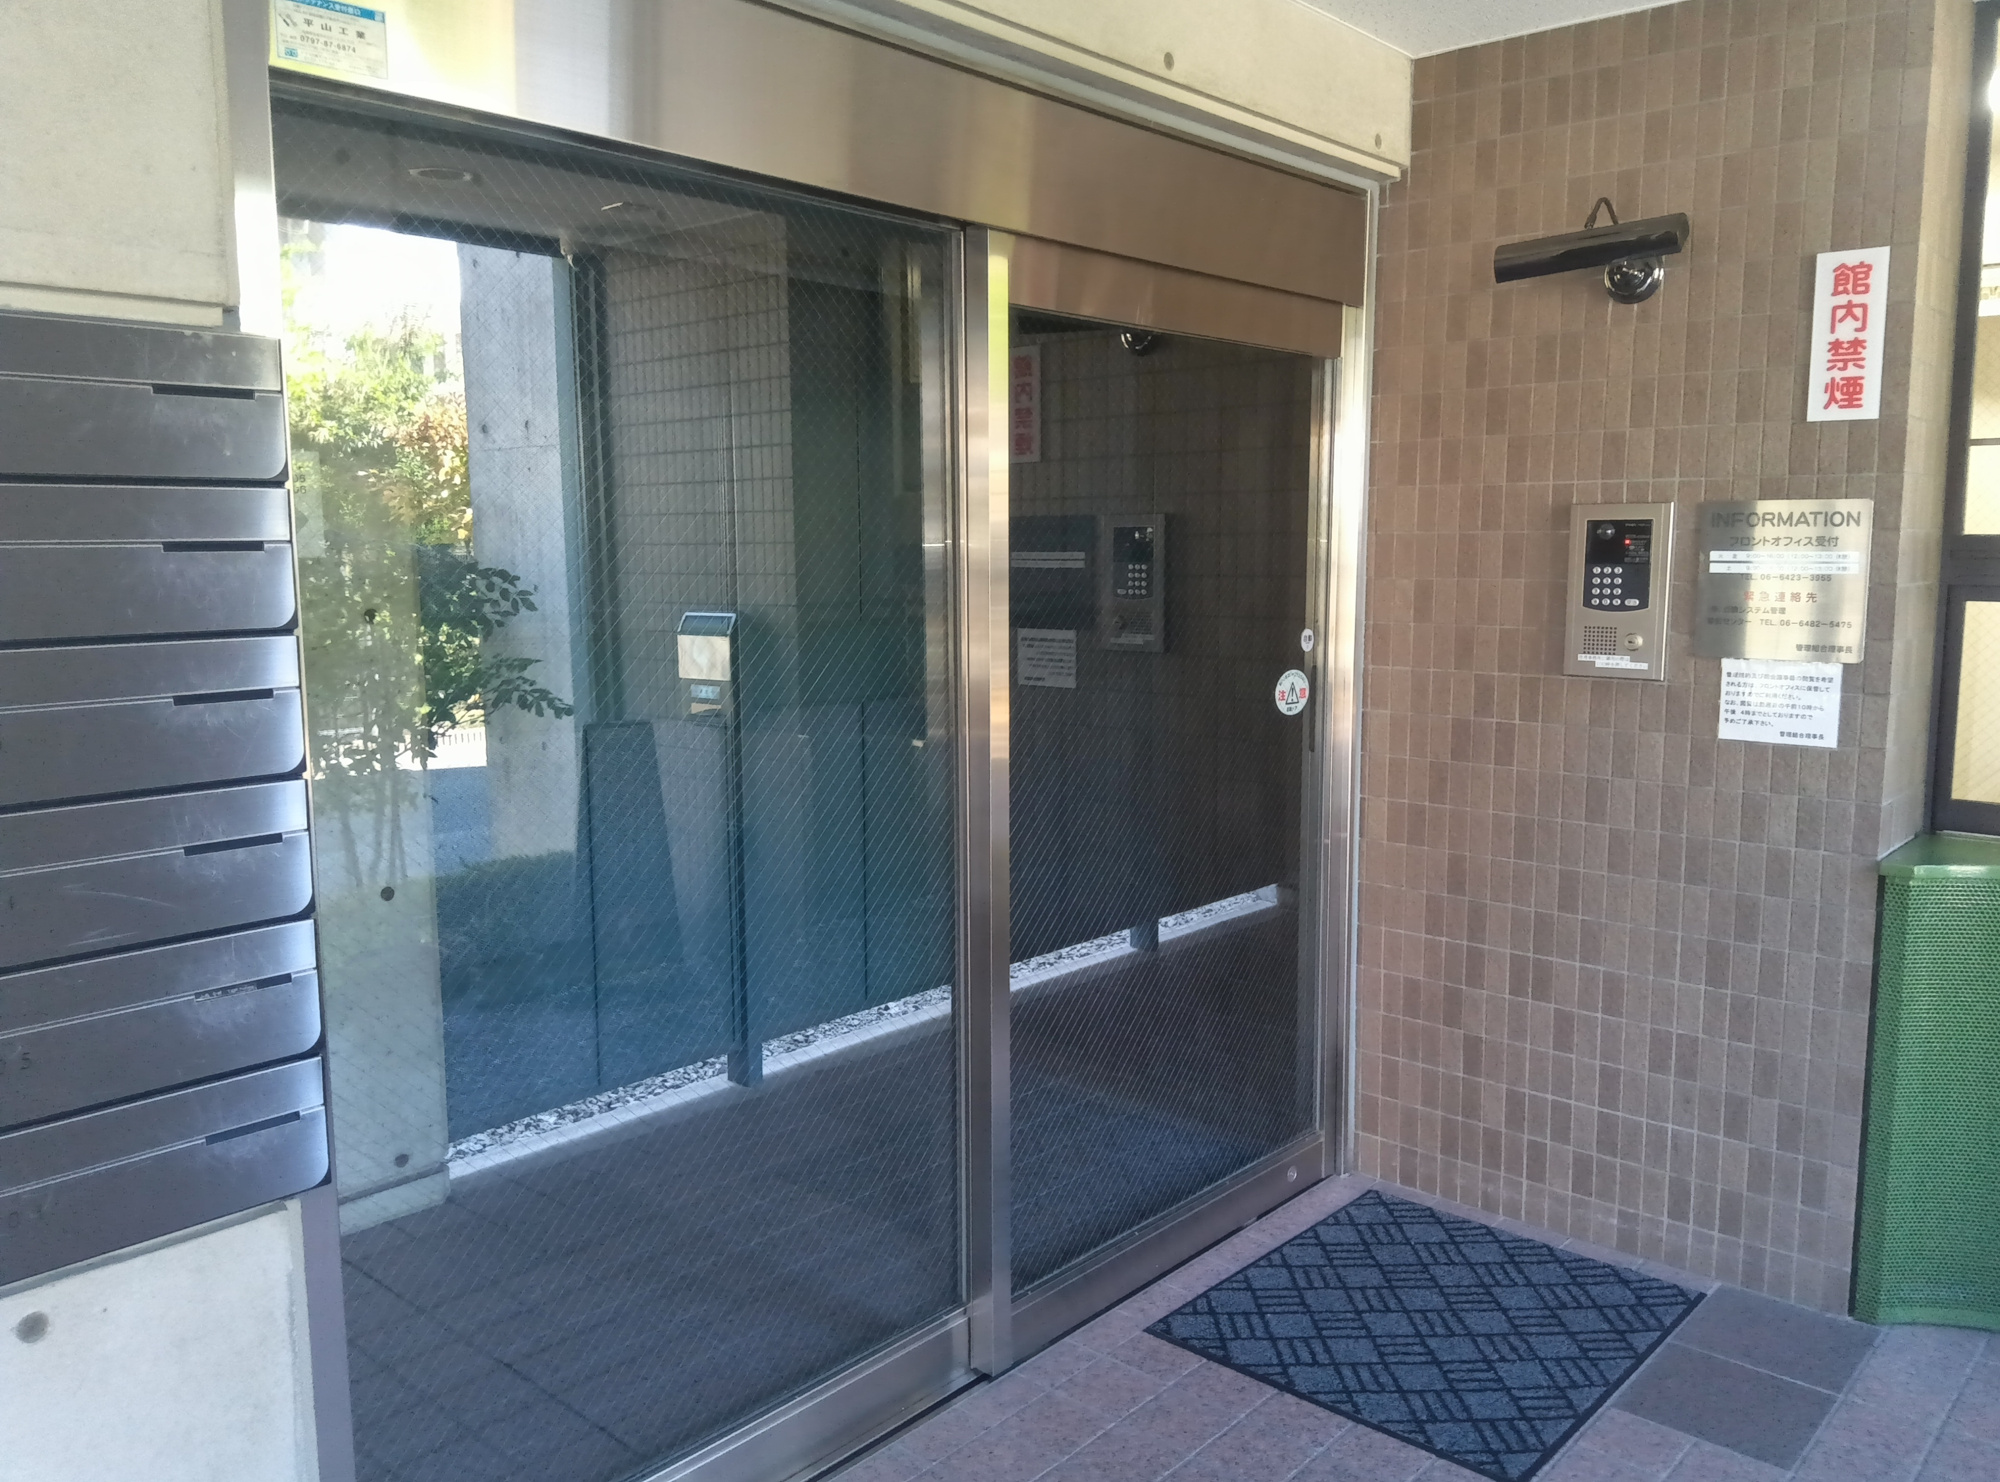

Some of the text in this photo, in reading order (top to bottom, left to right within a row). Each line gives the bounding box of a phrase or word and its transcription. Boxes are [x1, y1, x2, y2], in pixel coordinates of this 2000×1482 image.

[1823, 261, 1873, 410] 館内禁煙
[1710, 511, 1862, 528] INFORMATION
[1729, 535, 1840, 547] フロントオフィス受付
[1743, 591, 1818, 604] 緊急連絡先
[1795, 643, 1853, 655] 管理組合理事長
